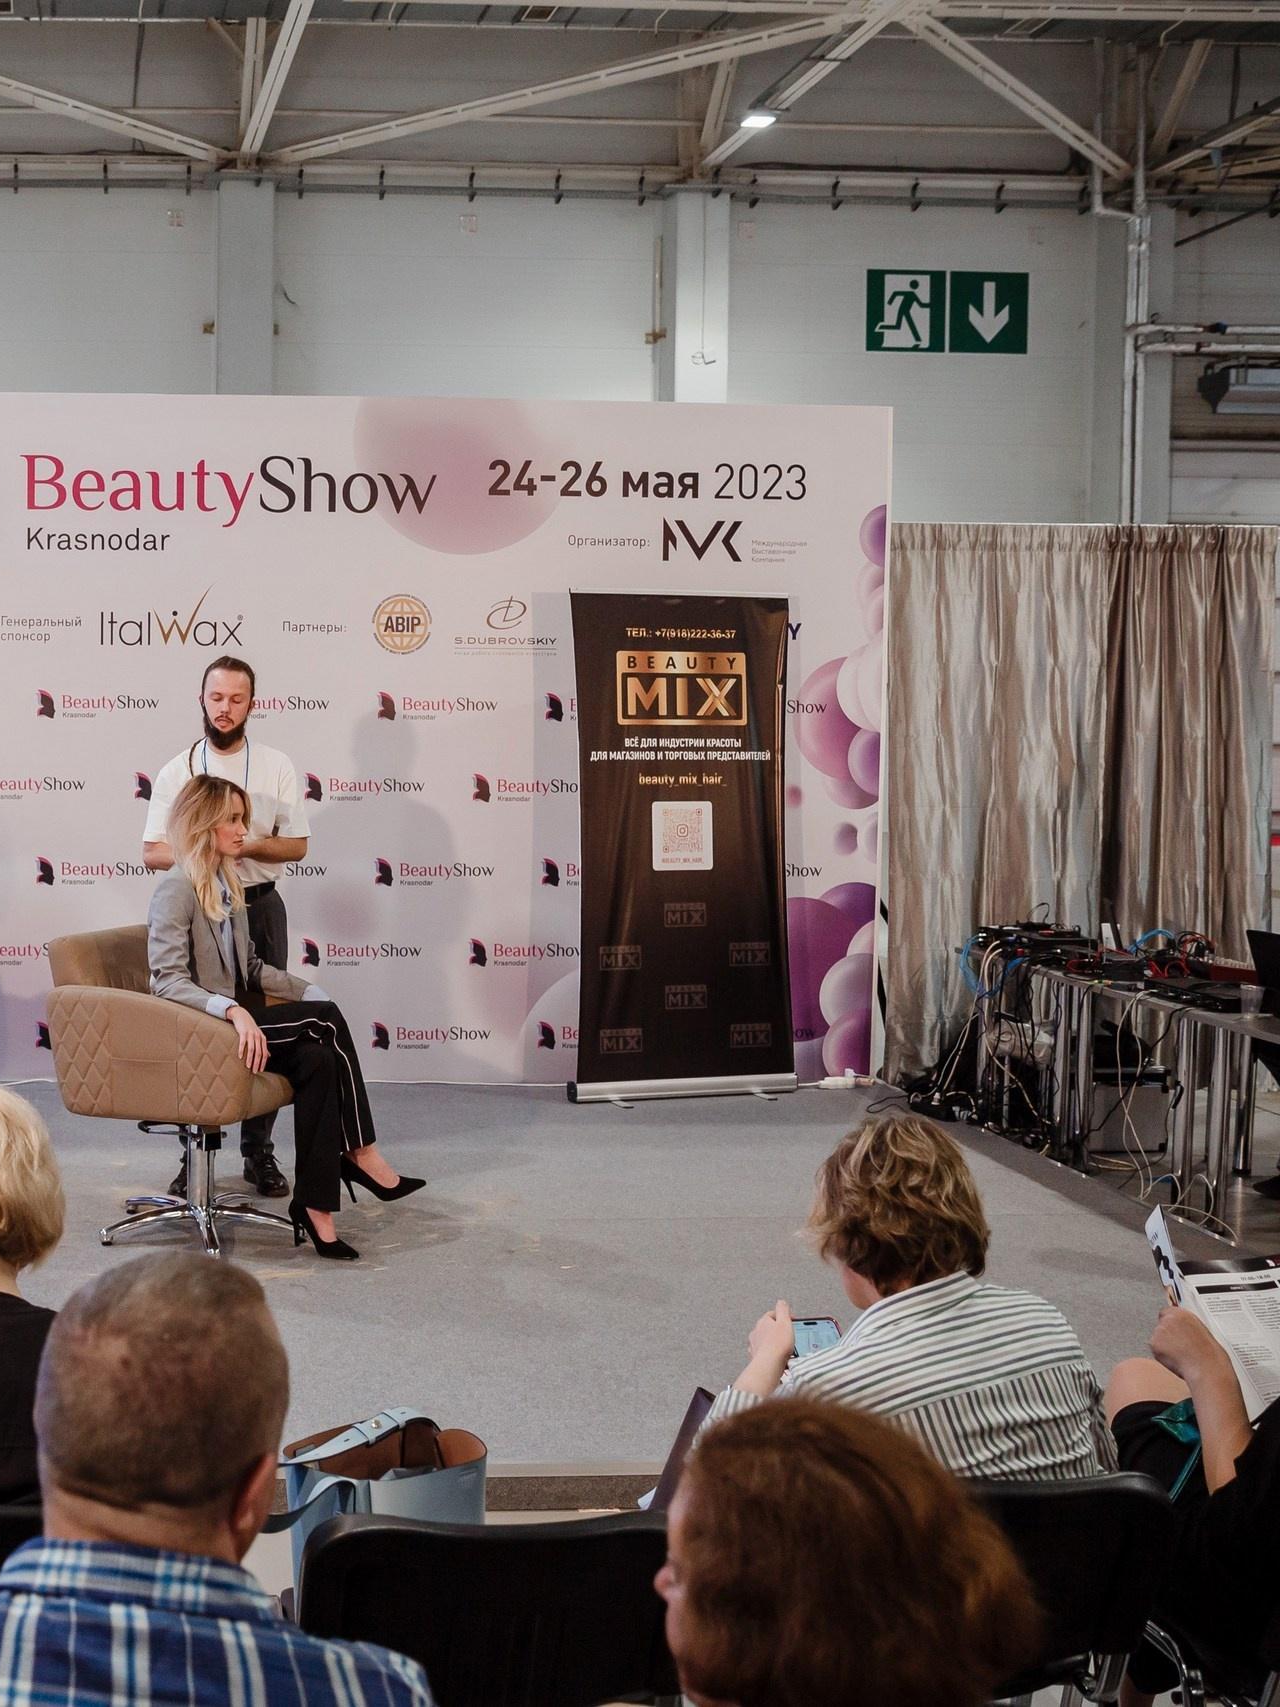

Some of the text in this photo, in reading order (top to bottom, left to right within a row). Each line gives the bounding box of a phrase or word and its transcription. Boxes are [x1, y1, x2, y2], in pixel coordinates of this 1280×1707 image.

[488, 459, 807, 501] 24-26 мая 2023
[20, 454, 437, 528] BeautyShow
[26, 527, 171, 552] Krasnodar
[567, 534, 651, 549] Организатор:
[0, 615, 83, 630] Генеральный
[282, 620, 348, 635] Партнеры:
[382, 615, 423, 634] ABIP
[0, 632, 51, 644] спонсор
[453, 636, 558, 646] S.DUBROVSKIY
[655, 628, 737, 641] +7(918)222-36-37
[627, 655, 737, 670] BEAUTY
[62, 695, 158, 712] BeautyShow
[402, 696, 498, 713] BeautyShow
[627, 677, 738, 717] MIX
[624, 735, 742, 748] ВСЁ ДЛЯ ИНДУСТРИИ КРАСОТЫ
[590, 750, 771, 762] ДЛЯ МАГАЗИНОВ И ТОРГОВЫХ ПРЕДСТАВИТЕЛЕЙ
[328, 777, 424, 794] BeautyShow
[496, 778, 577, 795] BeautySho
[400, 862, 496, 879] BeautyShow
[667, 910, 704, 925] MIX
[327, 943, 423, 960] BeautyShow
[732, 950, 767, 963] MIX
[602, 953, 637, 967] MIX
[667, 992, 705, 1007] MIX
[396, 1026, 492, 1043] BeautyShow
[731, 1031, 769, 1045] MIX
[603, 1037, 639, 1051] MIX
